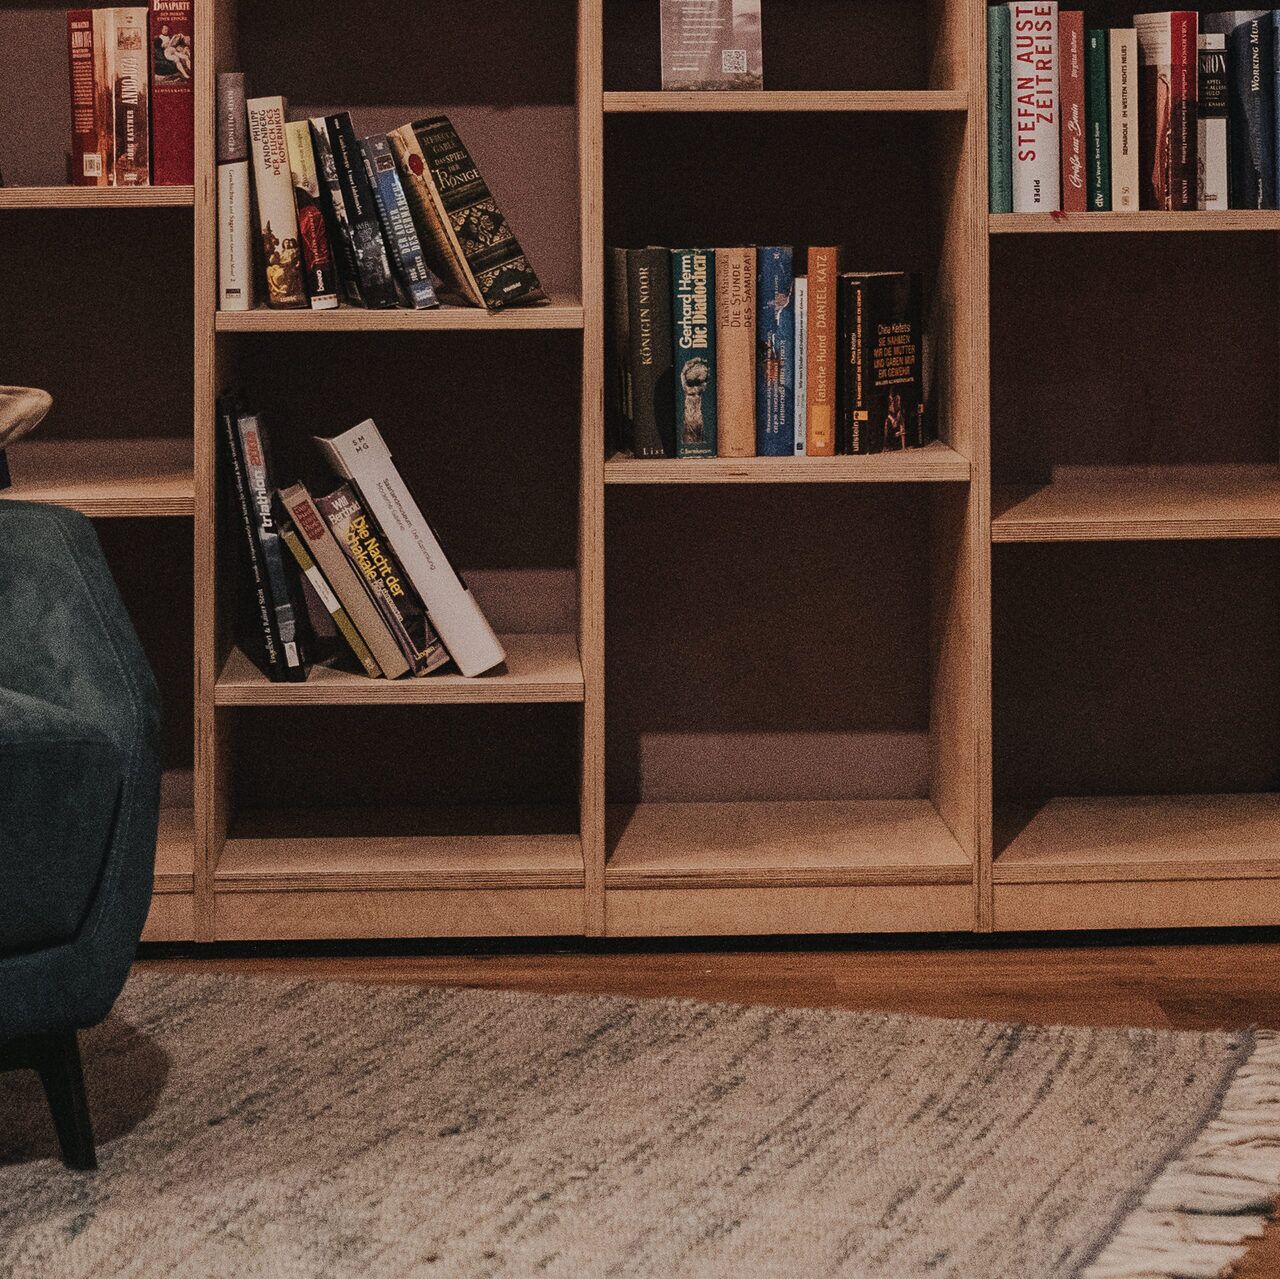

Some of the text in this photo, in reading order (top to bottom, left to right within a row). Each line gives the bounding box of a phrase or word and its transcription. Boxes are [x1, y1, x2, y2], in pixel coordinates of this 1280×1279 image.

[1016, 6, 1036, 162] STEFAN AUST
[1034, 6, 1053, 124] ZEITREISE
[1250, 20, 1260, 92] WORKING MUM
[121, 78, 138, 105] ANNO
[1068, 104, 1082, 136] Benin
[1122, 110, 1128, 118] IM
[126, 110, 134, 142] KASTNER
[251, 110, 260, 142] PHILIPP
[260, 108, 271, 169] VANDENBERG
[266, 108, 281, 176] DER FLUCH DES
[273, 108, 286, 164] KOPERNIKUS
[1068, 155, 1082, 188] Grüße
[1095, 193, 1104, 208] dtv
[390, 208, 410, 254] DER ADLER
[408, 234, 420, 252] DES
[721, 254, 730, 328] Takashi Matsuoka
[731, 264, 740, 328] DIE STUNDE
[742, 254, 752, 328] DES SAMURAI
[816, 254, 826, 283] KATZ
[639, 266, 652, 365] KÖNIGIN NOOR
[677, 255, 692, 348] Gerhard Herm
[692, 255, 707, 348] Die Diadochen
[816, 287, 826, 328] DANIEL
[816, 335, 826, 362] Hund
[254, 470, 272, 528] triathlon
[352, 515, 406, 599] Die Nacht der
